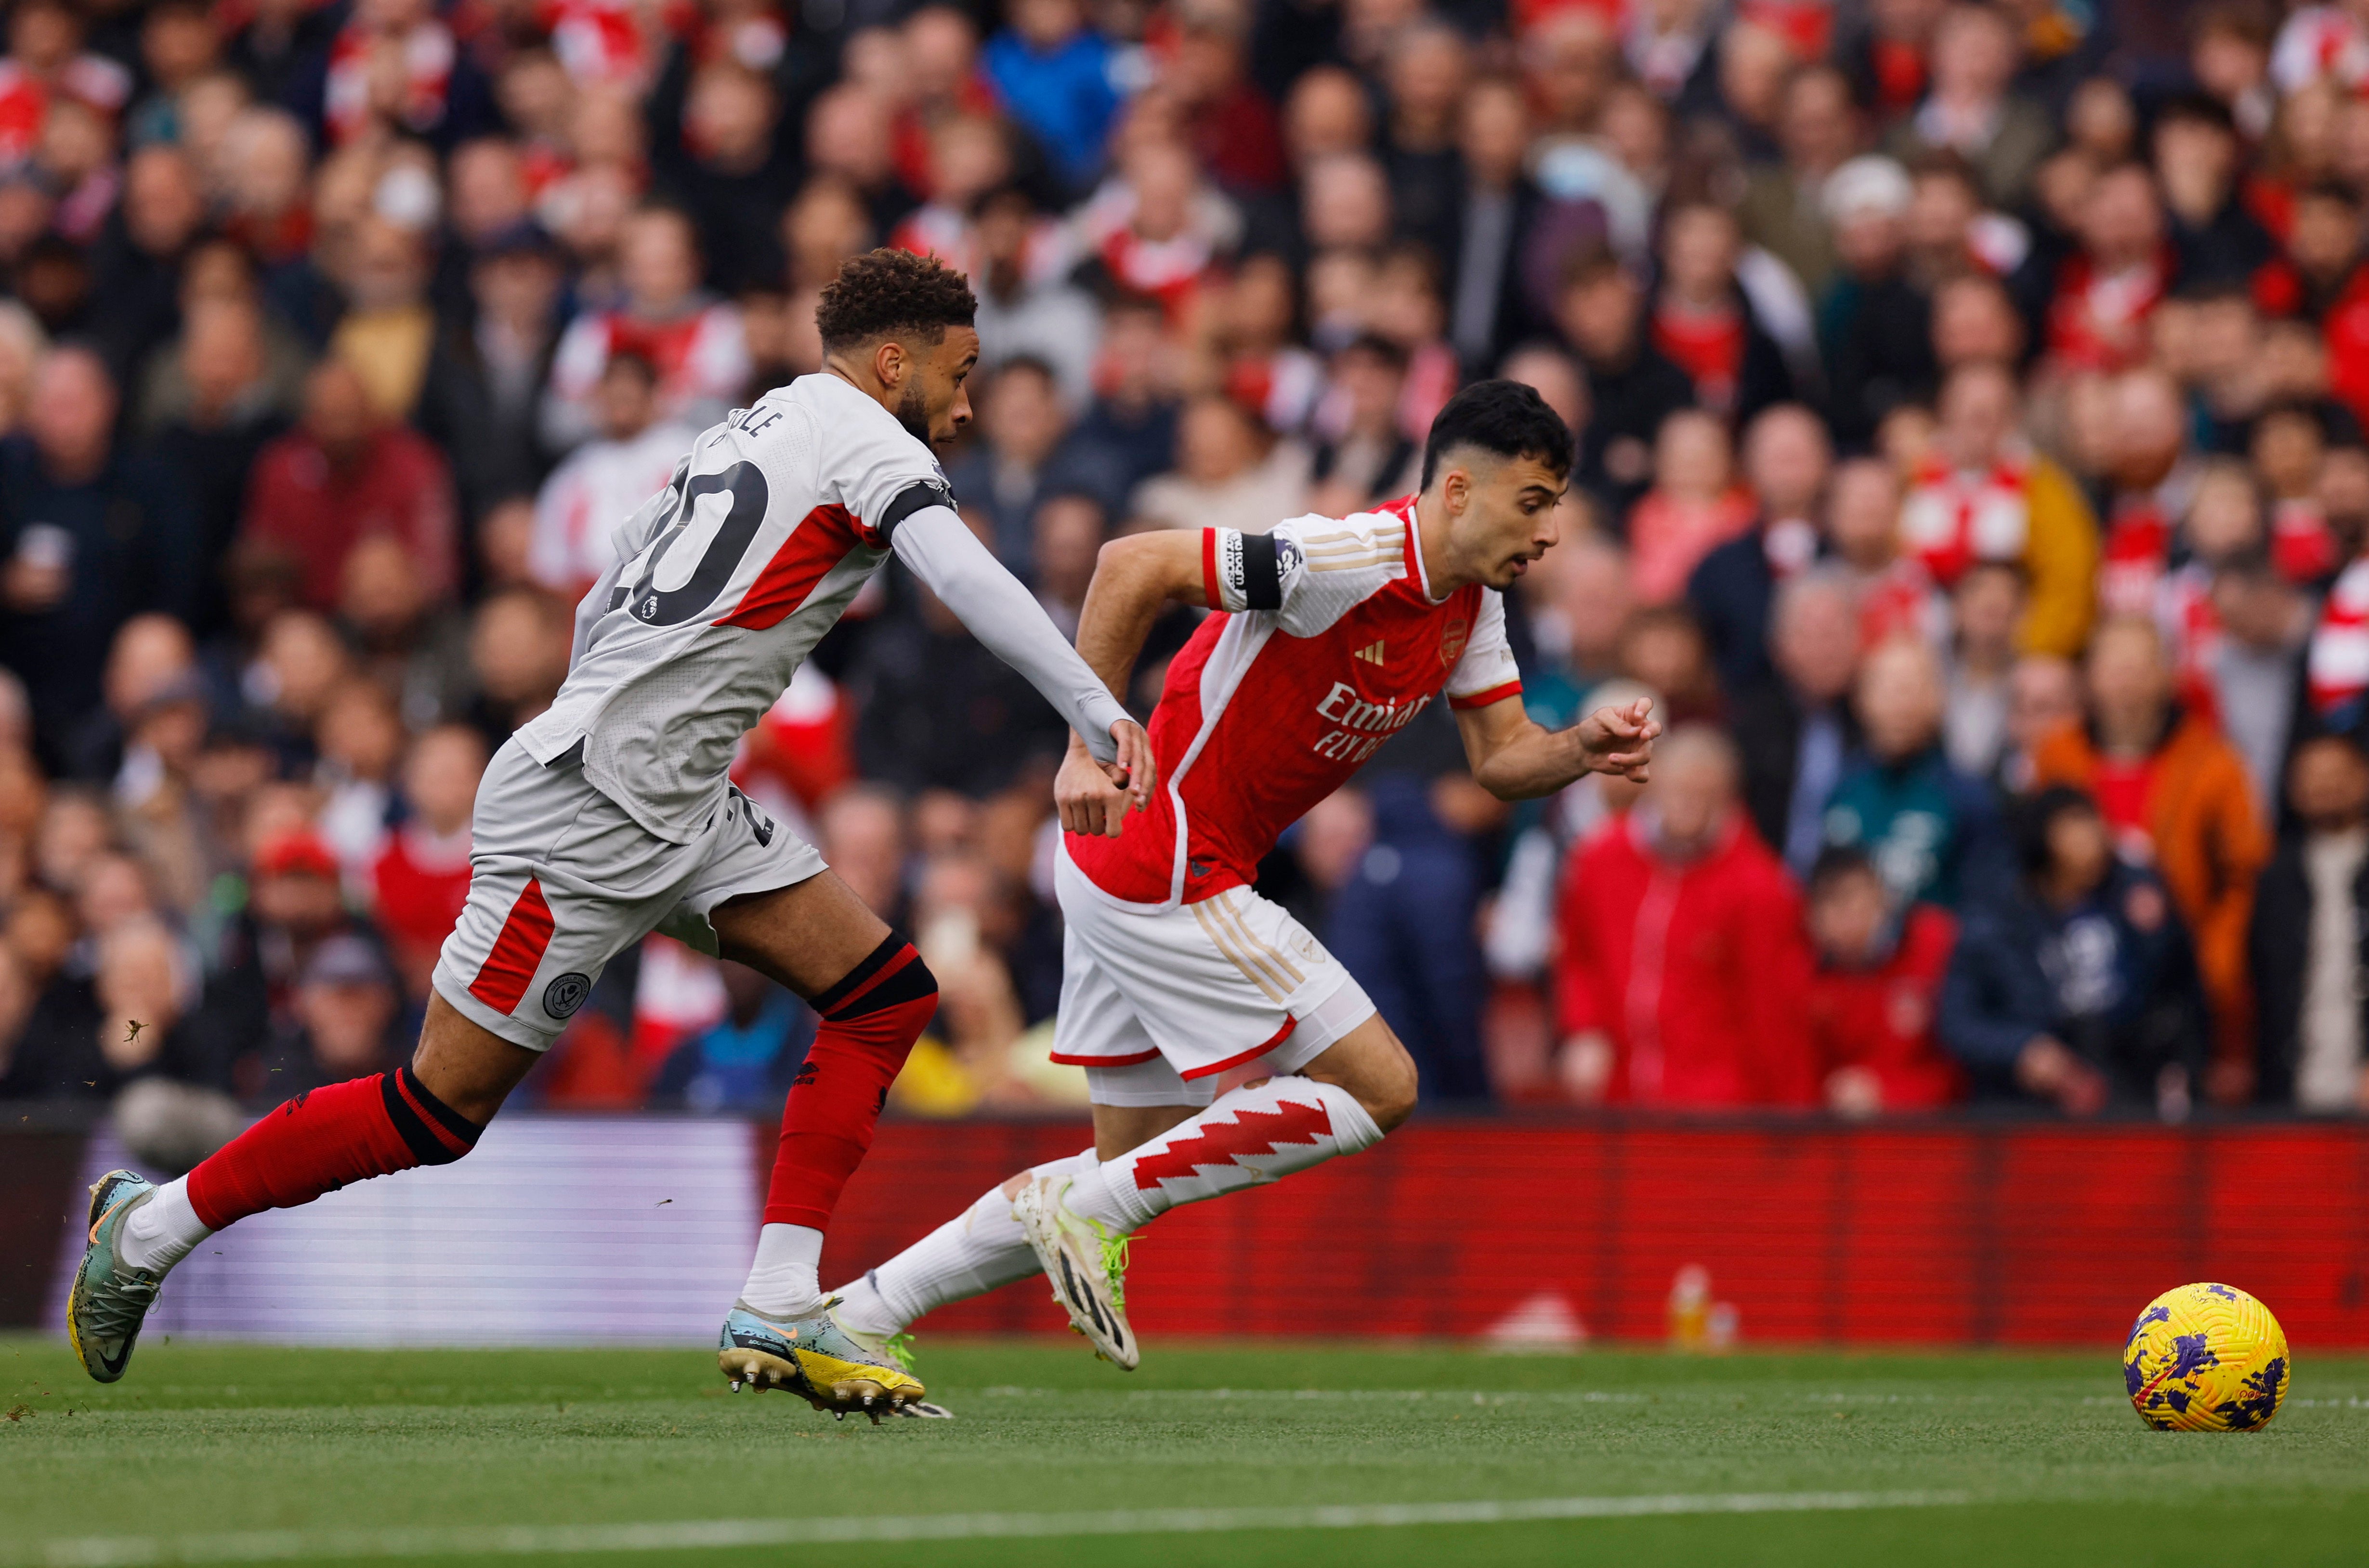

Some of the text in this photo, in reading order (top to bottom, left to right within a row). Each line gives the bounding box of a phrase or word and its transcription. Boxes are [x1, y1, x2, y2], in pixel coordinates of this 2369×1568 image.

[1316, 681, 1431, 732] Emirat
[1313, 730, 1363, 761] FLY
[726, 786, 775, 849] 2
[551, 977, 577, 992] SHEFFIELD
